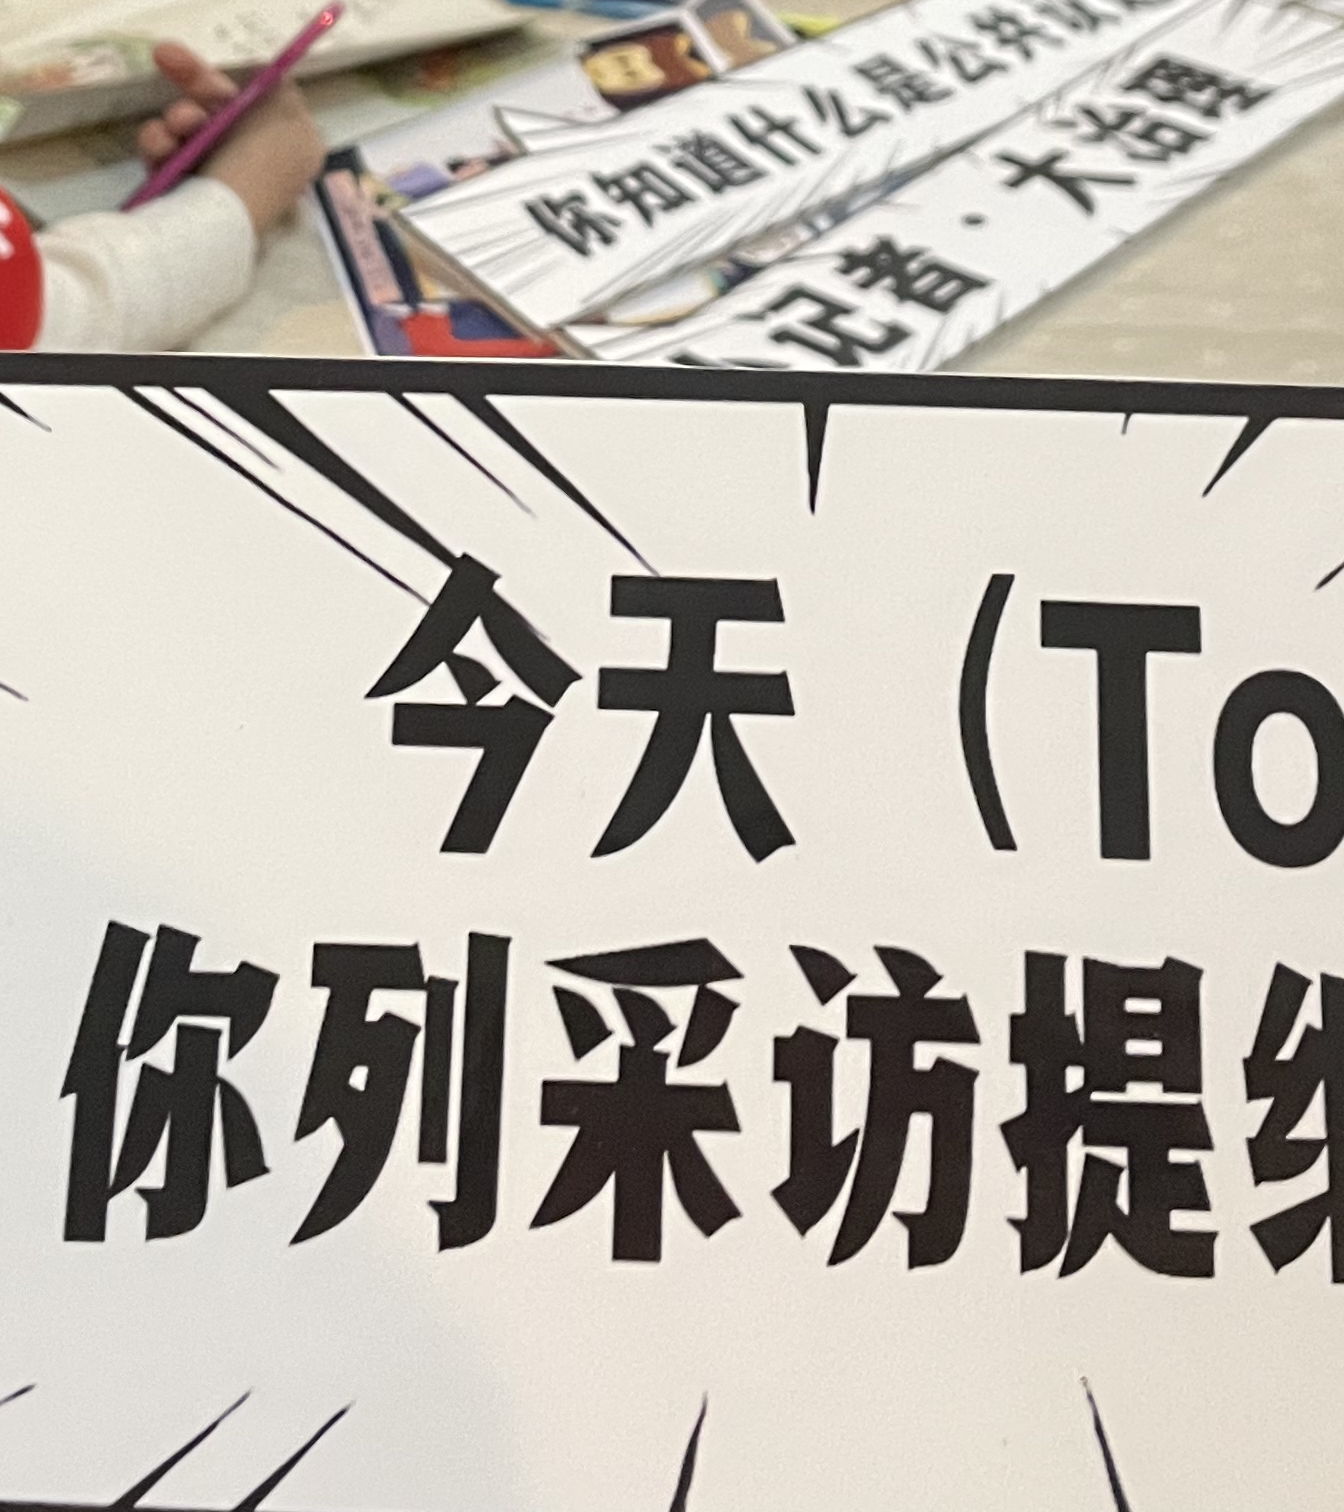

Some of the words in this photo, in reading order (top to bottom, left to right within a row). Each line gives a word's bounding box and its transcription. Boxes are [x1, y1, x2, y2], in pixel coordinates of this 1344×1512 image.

[668, 54, 1272, 368] 记者·大治理
